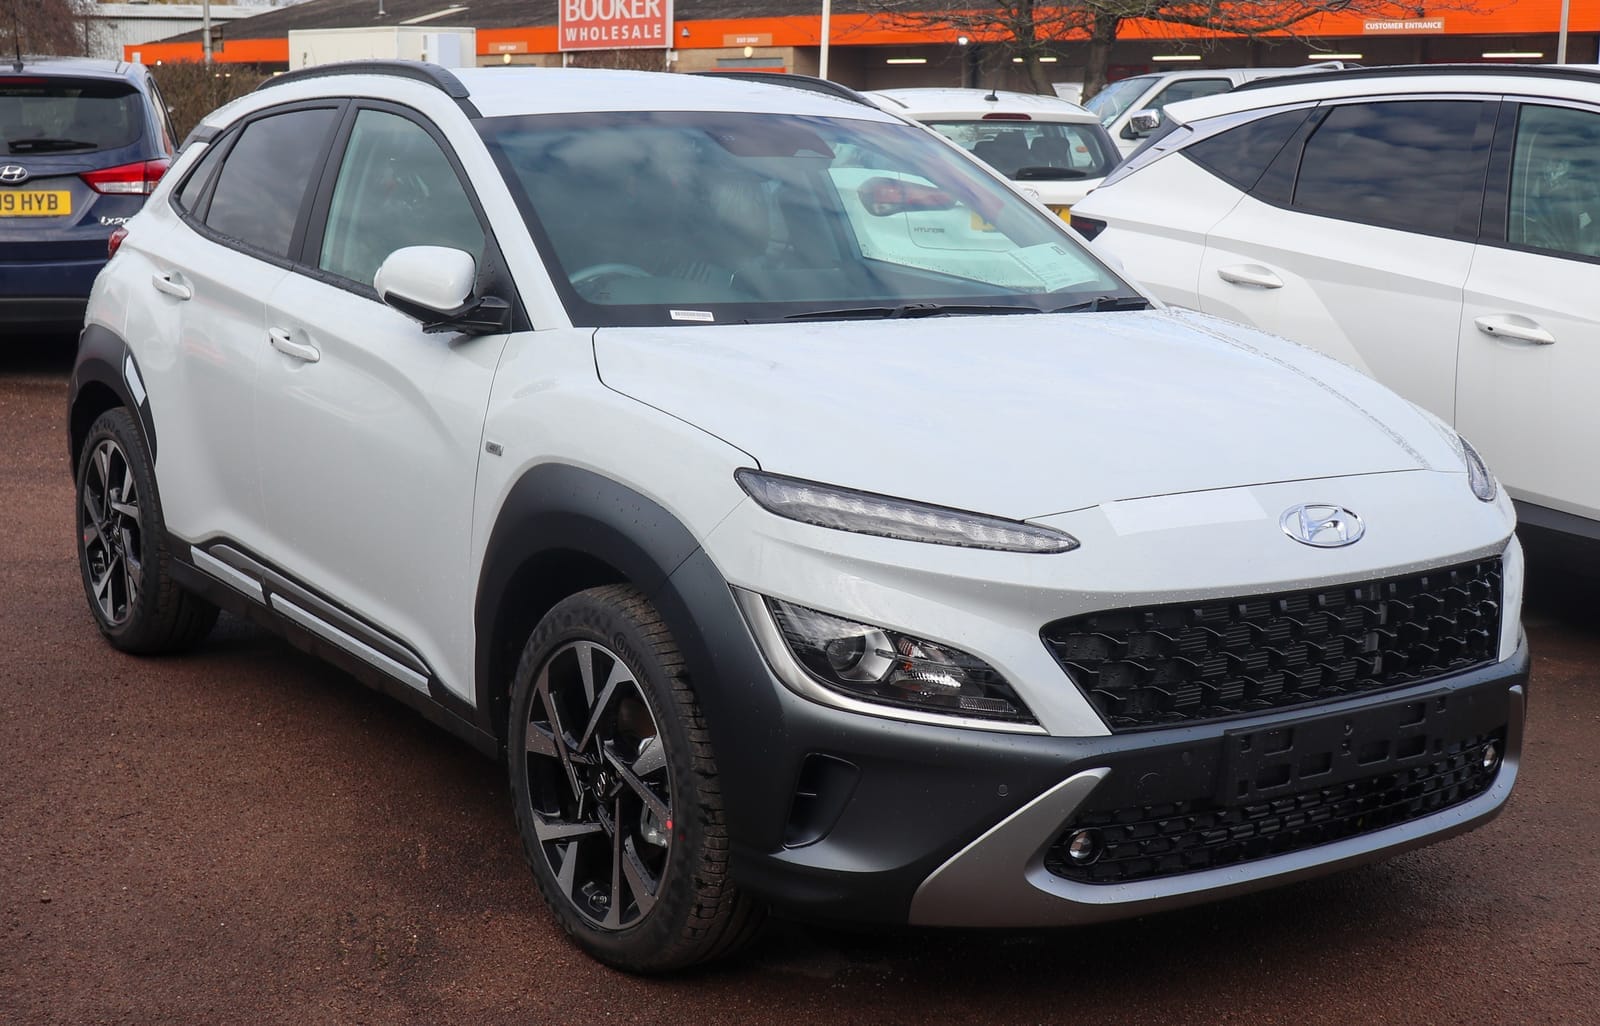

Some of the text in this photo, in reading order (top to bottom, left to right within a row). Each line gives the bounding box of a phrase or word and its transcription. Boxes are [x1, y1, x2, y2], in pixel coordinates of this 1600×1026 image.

[565, 0, 662, 21] BOOKER
[565, 24, 662, 41] WHOLESALE
[21, 193, 58, 210] HYB
